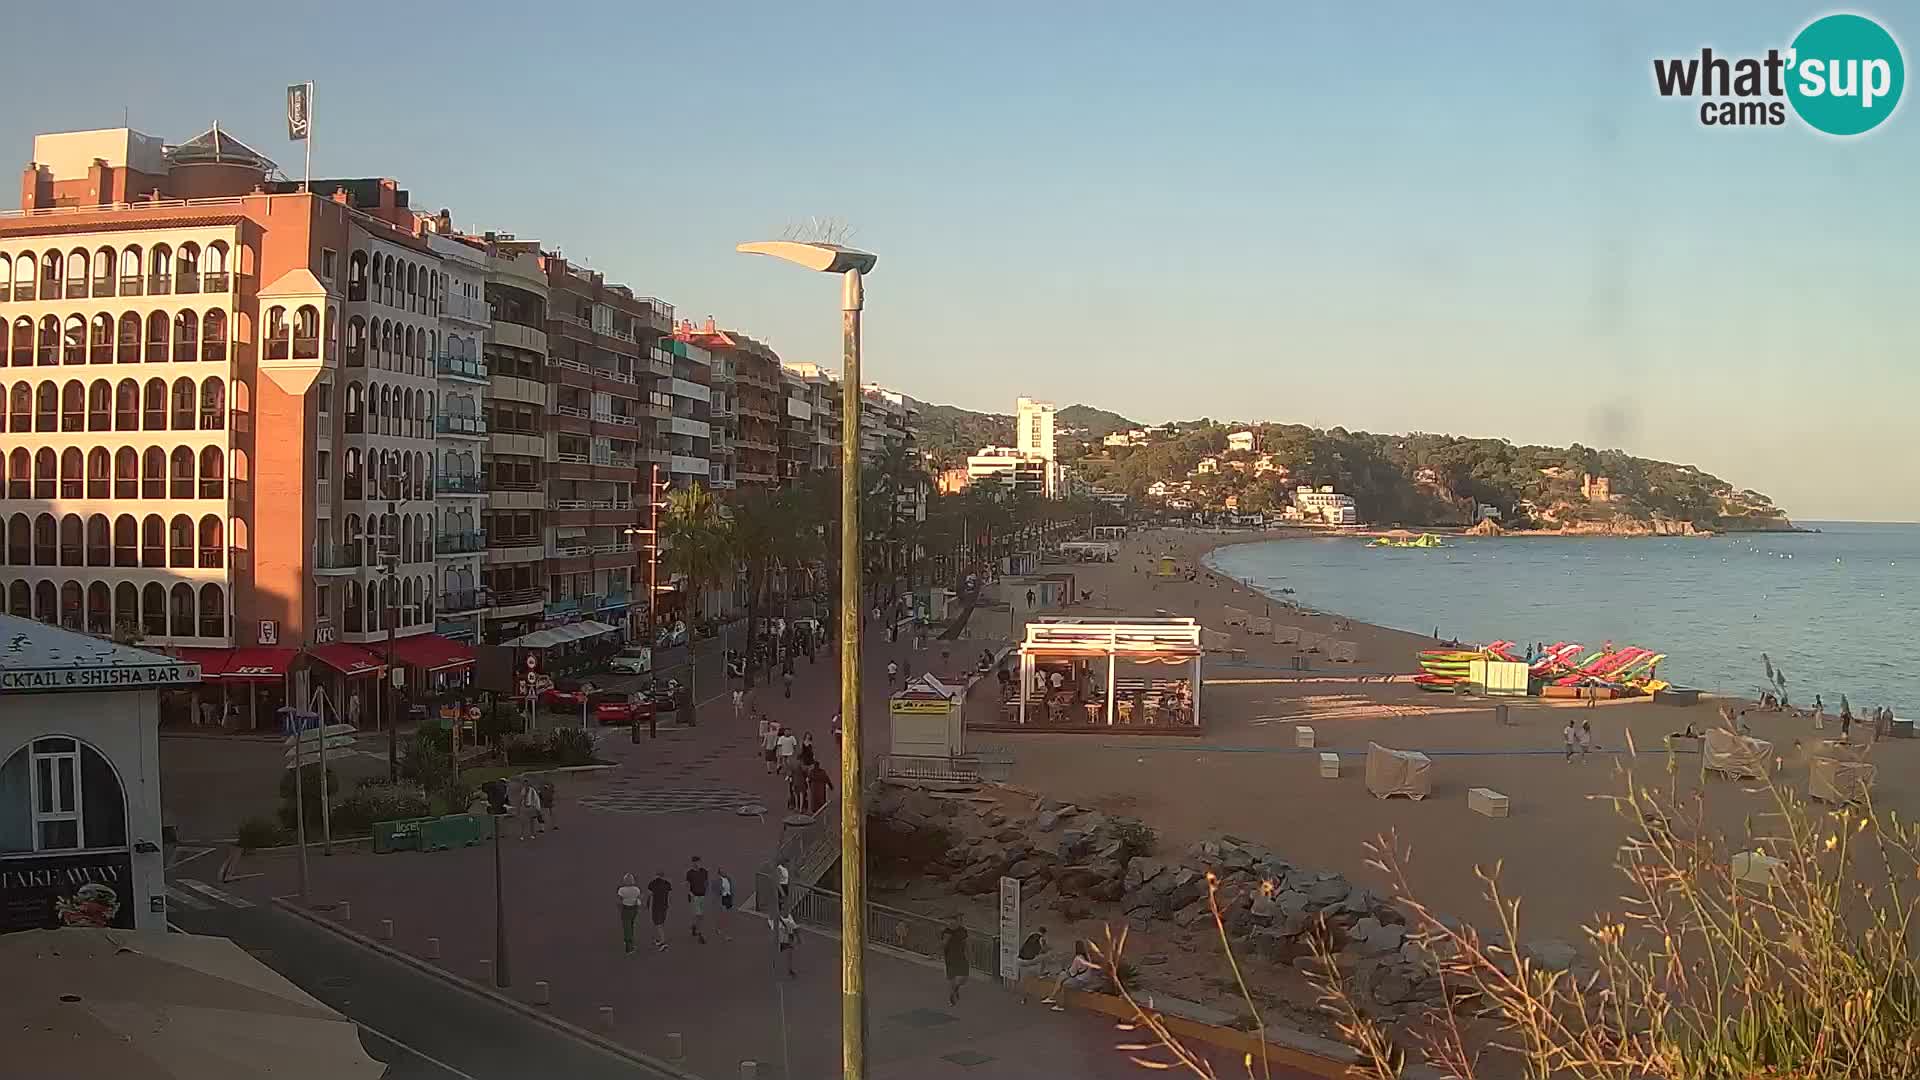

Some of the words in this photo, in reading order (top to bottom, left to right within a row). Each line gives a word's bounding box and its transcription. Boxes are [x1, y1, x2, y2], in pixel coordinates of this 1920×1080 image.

[315, 627, 335, 643] KFC
[65, 671, 76, 685] &
[81, 669, 142, 685] SHISHA
[148, 667, 180, 682] BAR
